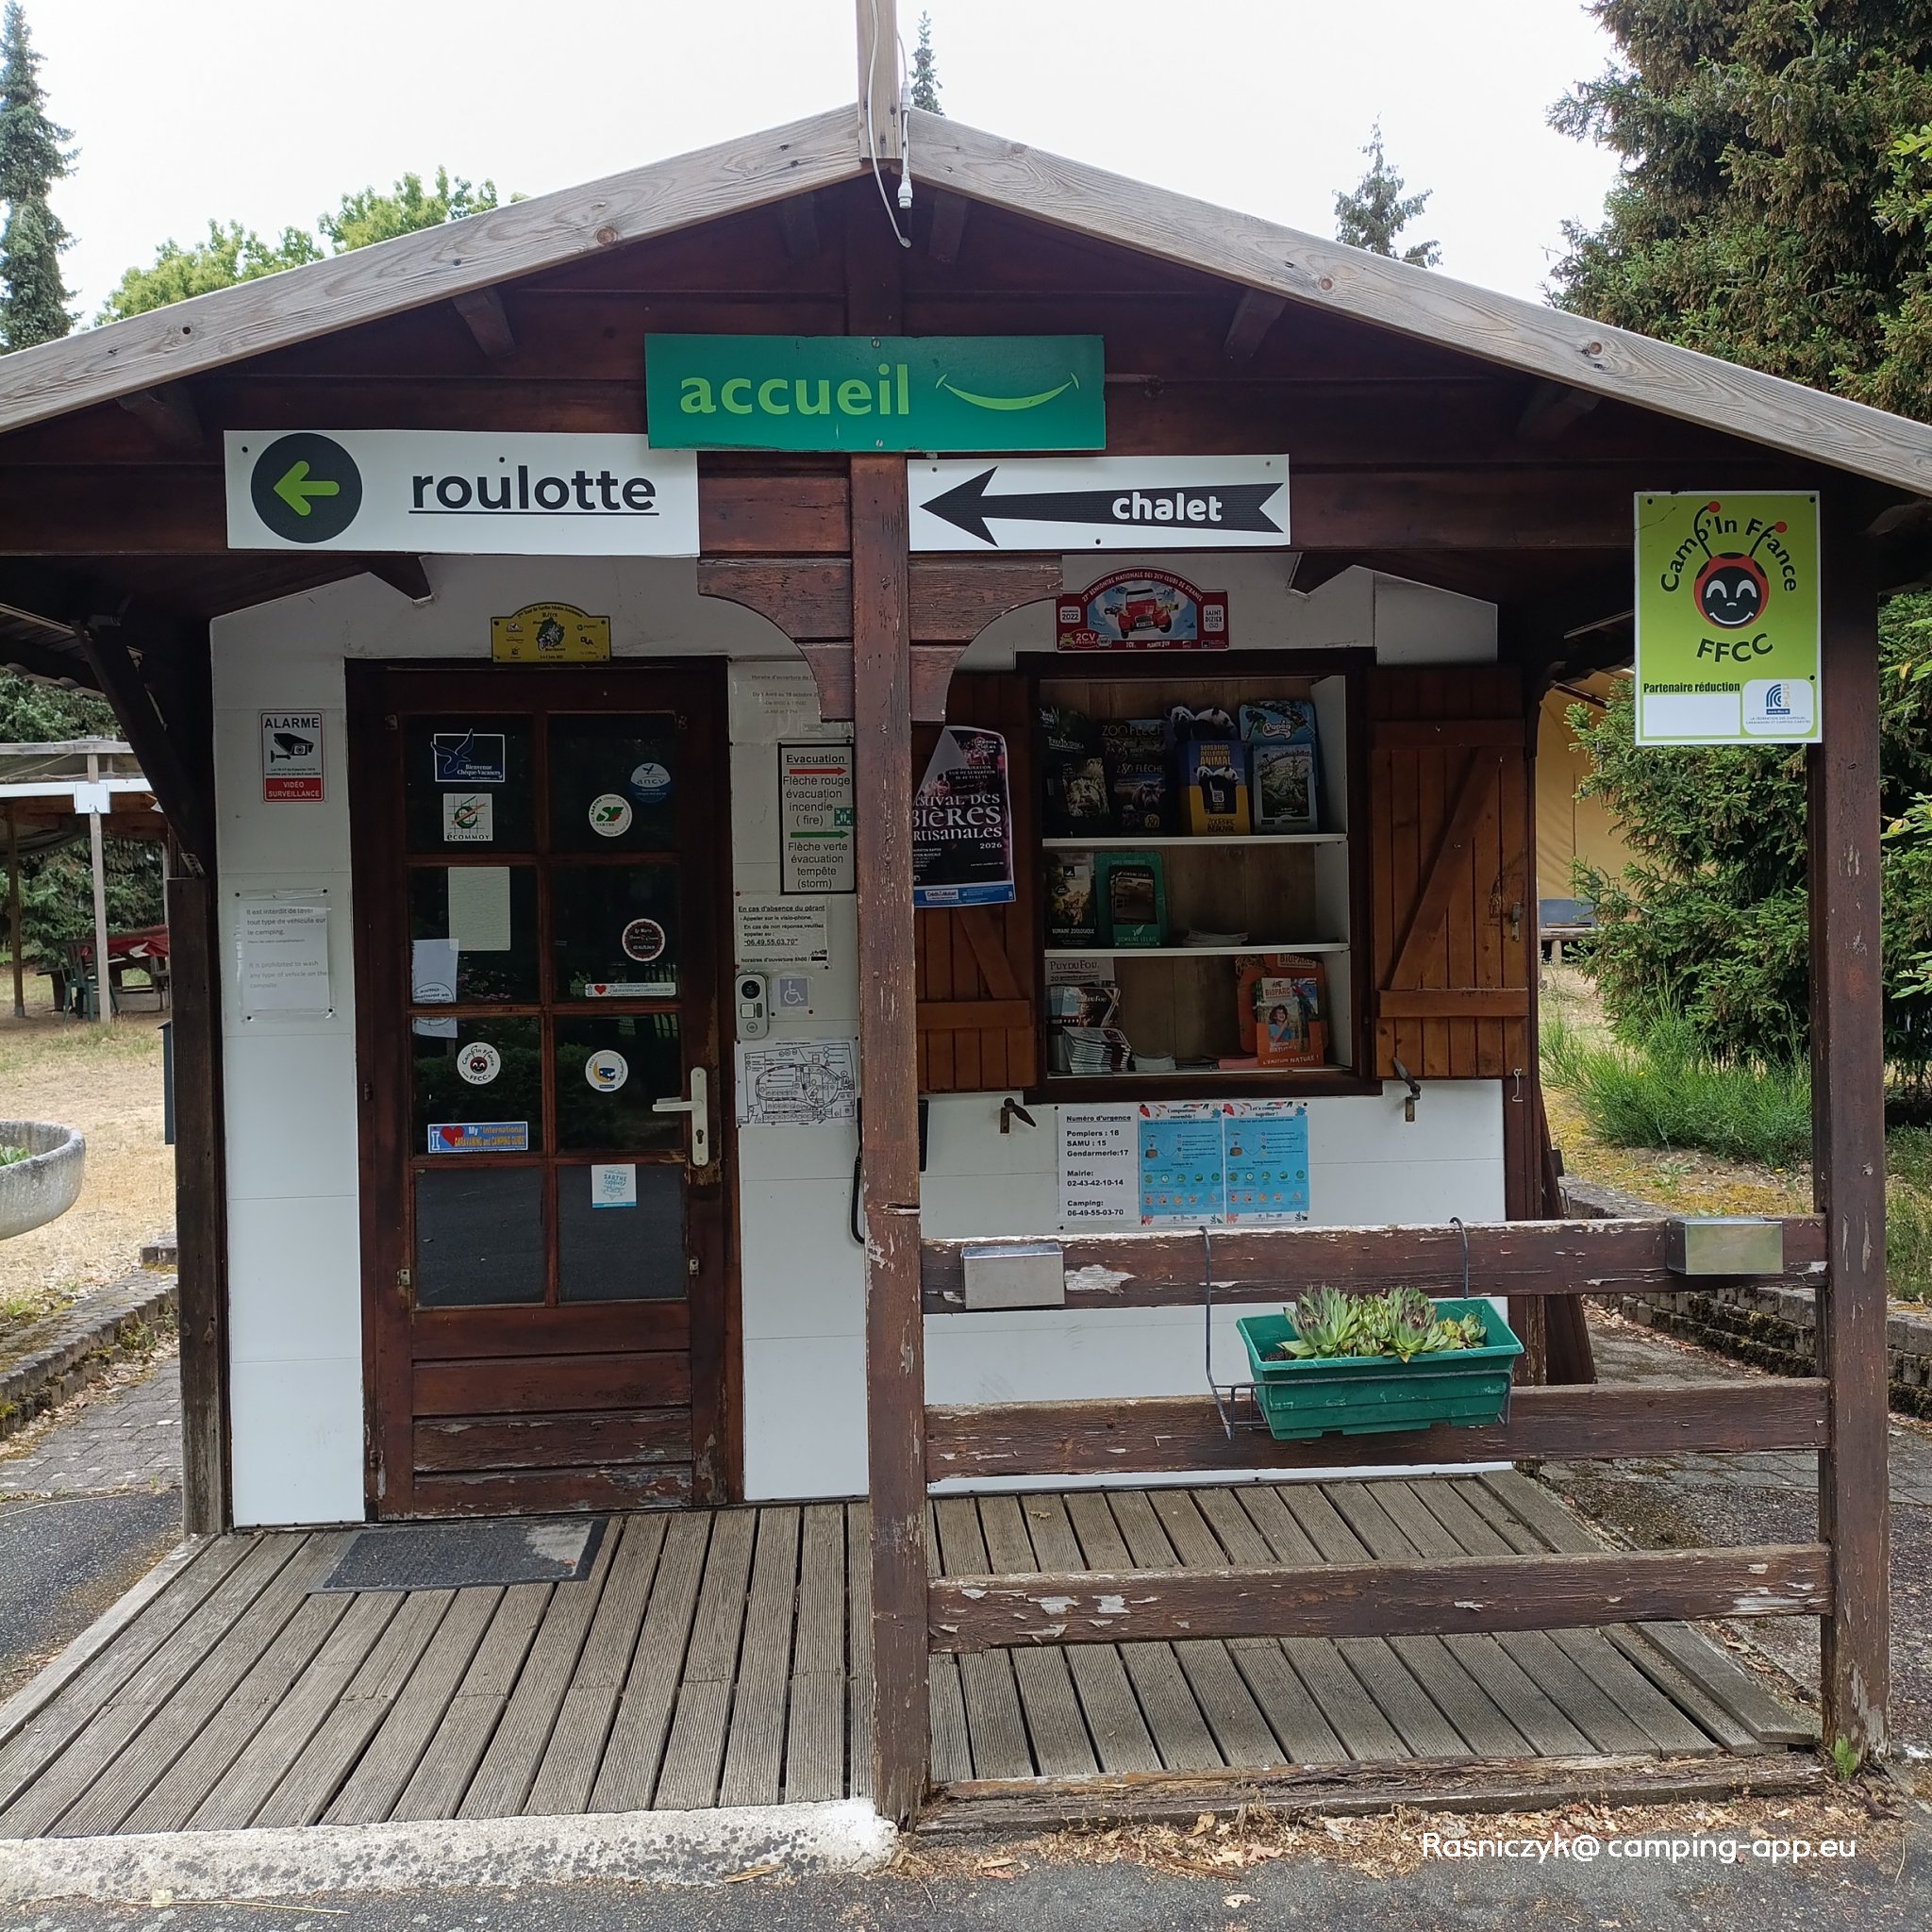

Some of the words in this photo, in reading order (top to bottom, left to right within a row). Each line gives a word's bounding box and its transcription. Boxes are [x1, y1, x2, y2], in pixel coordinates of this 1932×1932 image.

[680, 364, 909, 416] accueil
[412, 465, 656, 510] roulotte
[1112, 492, 1223, 522] chalet
[1115, 572, 1143, 582] NATIONALE
[1164, 575, 1178, 585] CLUBS
[1186, 585, 1204, 602] FRANCE
[1075, 633, 1095, 641] 2CV
[1696, 633, 1774, 663] FFCC
[1643, 683, 1693, 693] Partenaire
[1695, 681, 1740, 692] réduction
[264, 718, 320, 729] ALARME
[1102, 724, 1127, 736] ZOO
[786, 754, 845, 763] Evacuation
[1200, 757, 1231, 766] ANIMAL
[821, 777, 851, 788] rouge
[268, 790, 320, 798] SURVEILLANCE
[786, 789, 842, 798] évacuation
[789, 802, 833, 811] incendie
[791, 855, 843, 863] évacuation
[797, 866, 837, 877] tempête
[797, 878, 832, 890] (storm)
[261, 960, 293, 970] prohibited
[1265, 987, 1291, 996] BIOPARC
[468, 1126, 478, 1136] My
